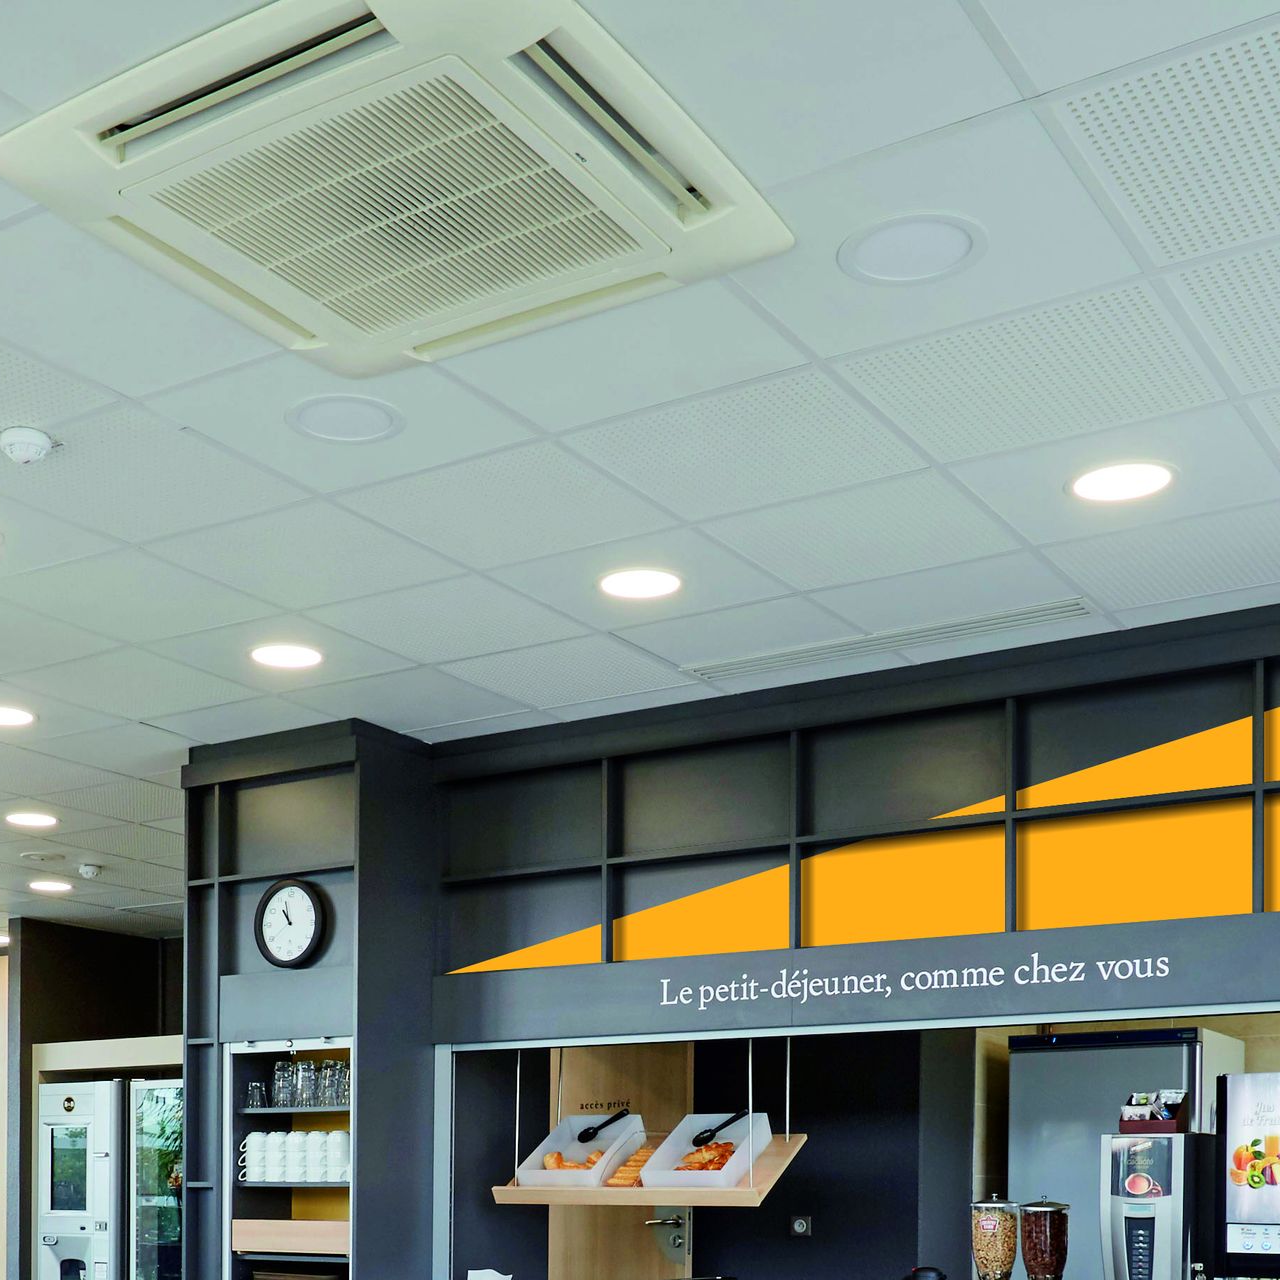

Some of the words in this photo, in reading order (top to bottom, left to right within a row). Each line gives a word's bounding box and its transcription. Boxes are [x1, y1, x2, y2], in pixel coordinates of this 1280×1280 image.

[660, 979, 693, 1006] Le
[698, 967, 893, 1011] petit-déjeuner,
[900, 966, 1006, 992] comme
[1013, 952, 1086, 985] chez
[1095, 955, 1170, 981] vous
[580, 1100, 604, 1110] accès
[607, 1098, 631, 1110] privé
